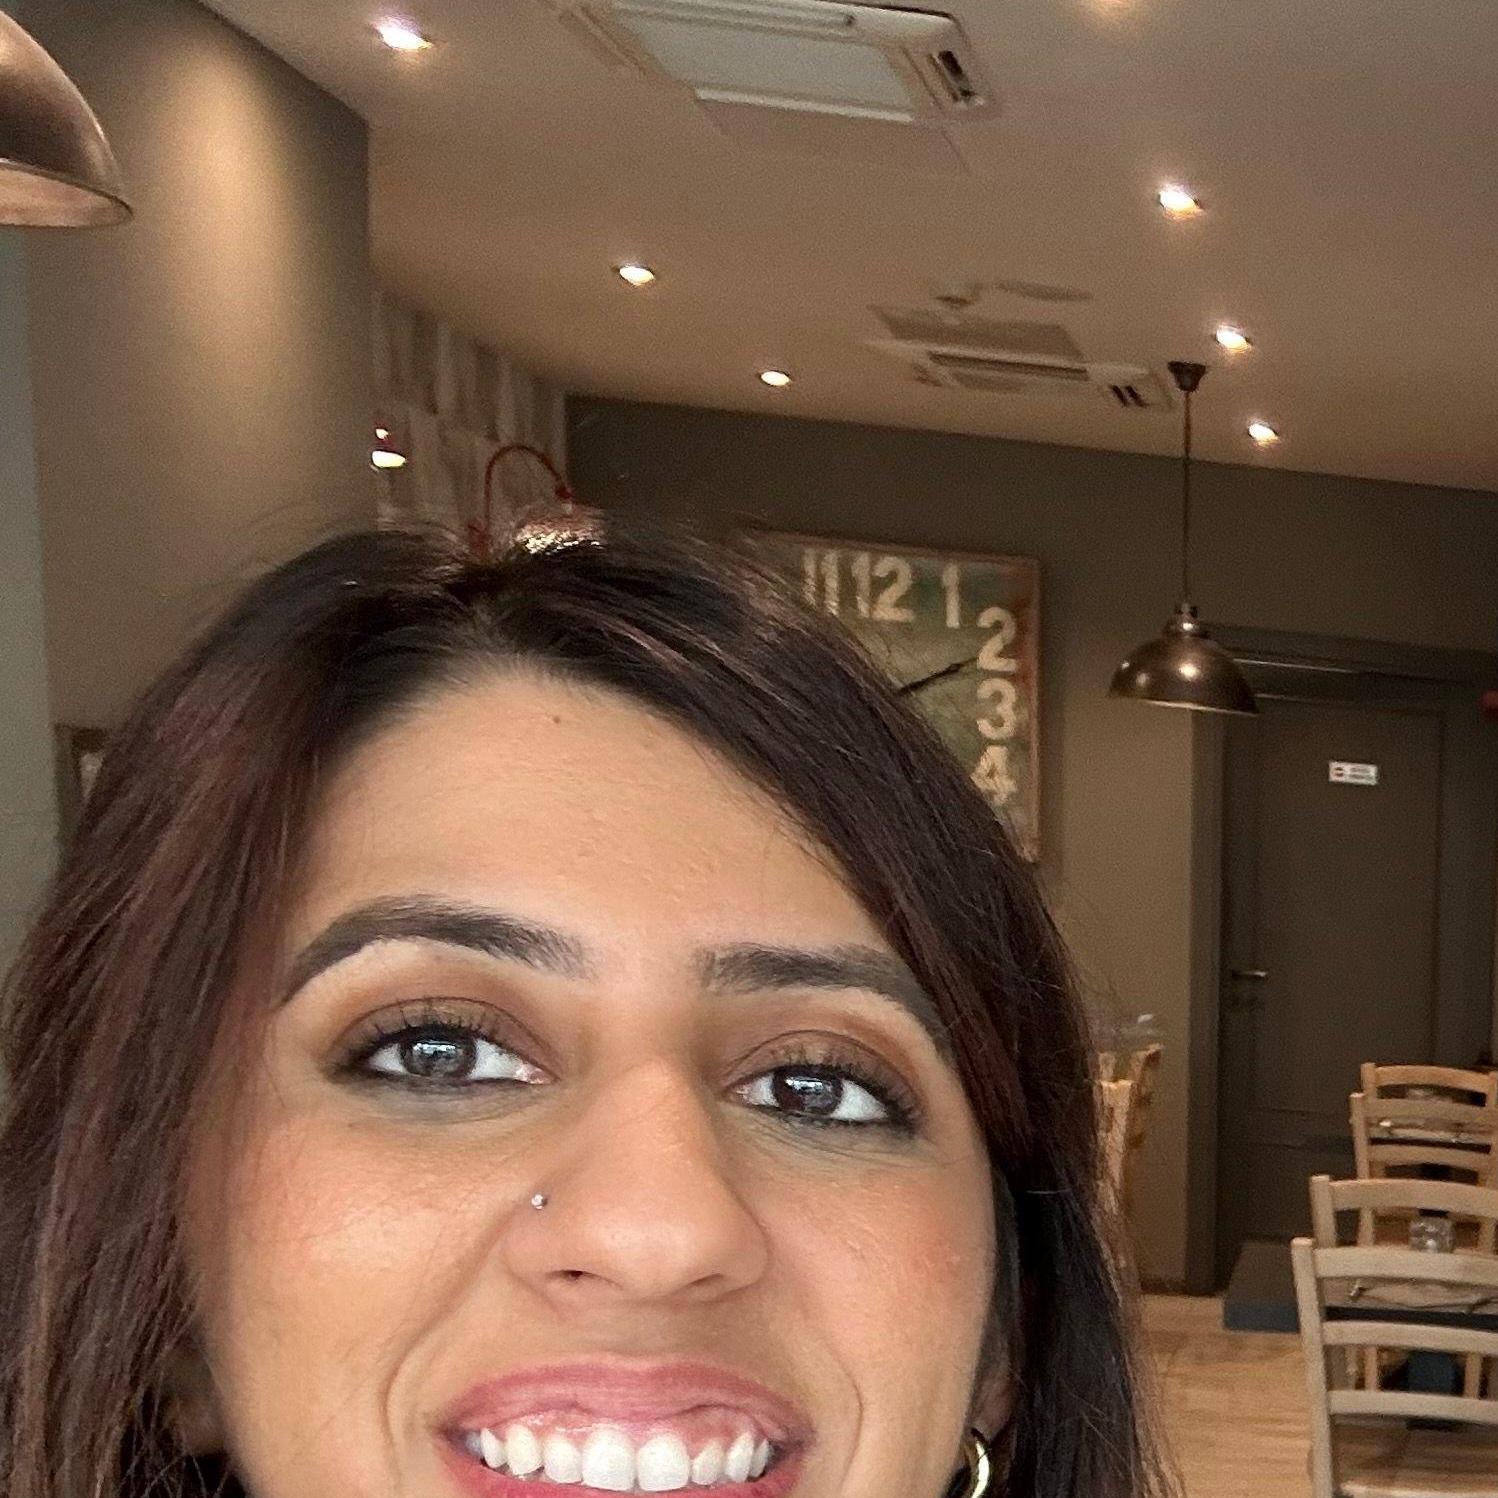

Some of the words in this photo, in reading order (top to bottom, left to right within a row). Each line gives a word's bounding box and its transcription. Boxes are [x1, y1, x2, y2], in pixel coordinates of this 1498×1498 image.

[851, 551, 917, 622] 12
[942, 563, 961, 629] 1
[976, 606, 1017, 673] 2
[976, 677, 1017, 740] 3
[969, 745, 1018, 807] 4
